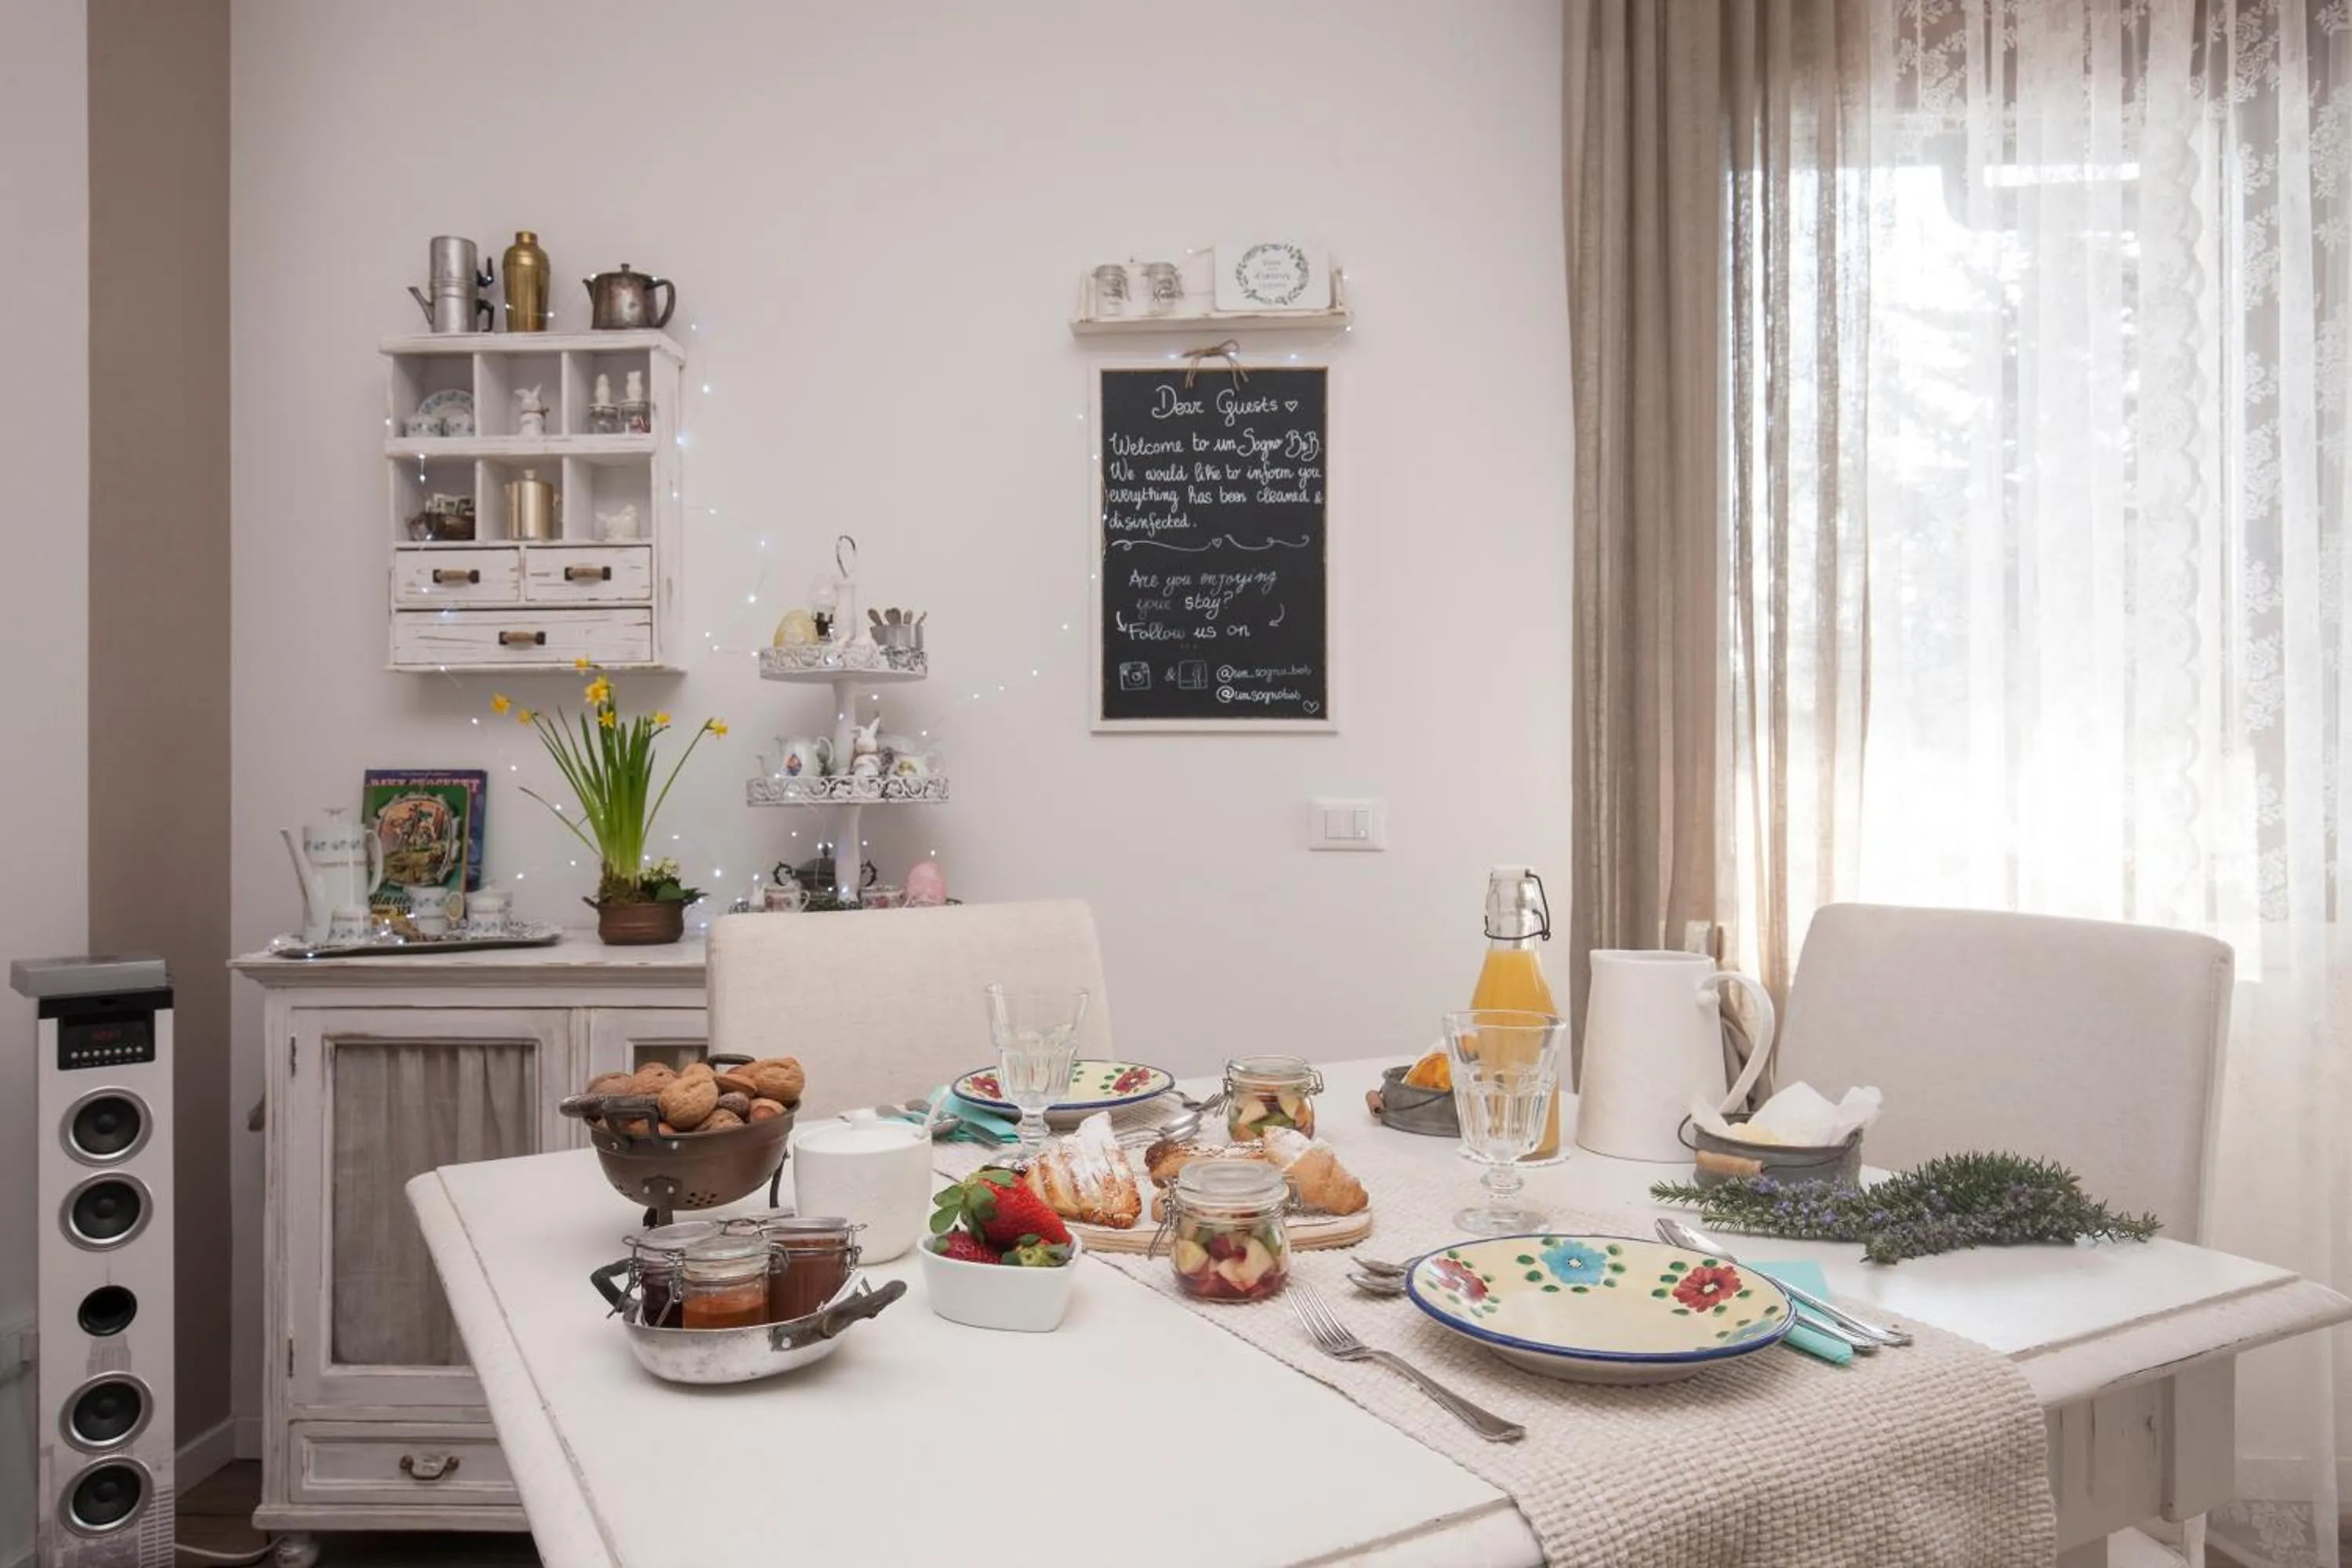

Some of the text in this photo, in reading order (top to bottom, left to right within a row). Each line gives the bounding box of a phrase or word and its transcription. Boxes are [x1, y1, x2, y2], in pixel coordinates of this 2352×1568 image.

[1152, 385, 1278, 426] Dear Guests
[1109, 433, 1184, 456] Welcome
[1192, 432, 1209, 452] to
[1214, 438, 1236, 452] un
[1236, 427, 1283, 461] Sogno
[1110, 457, 1322, 488] We would like to inform you
[1109, 486, 1179, 513] everything
[1188, 485, 1213, 503] has
[1219, 486, 1247, 503] been
[1257, 487, 1310, 503] cleaned
[1109, 510, 1197, 537] disinfected.
[1129, 568, 1277, 597] Are you enjoying
[1137, 590, 1233, 619] your stay?
[1128, 622, 1250, 641] Follow us on
